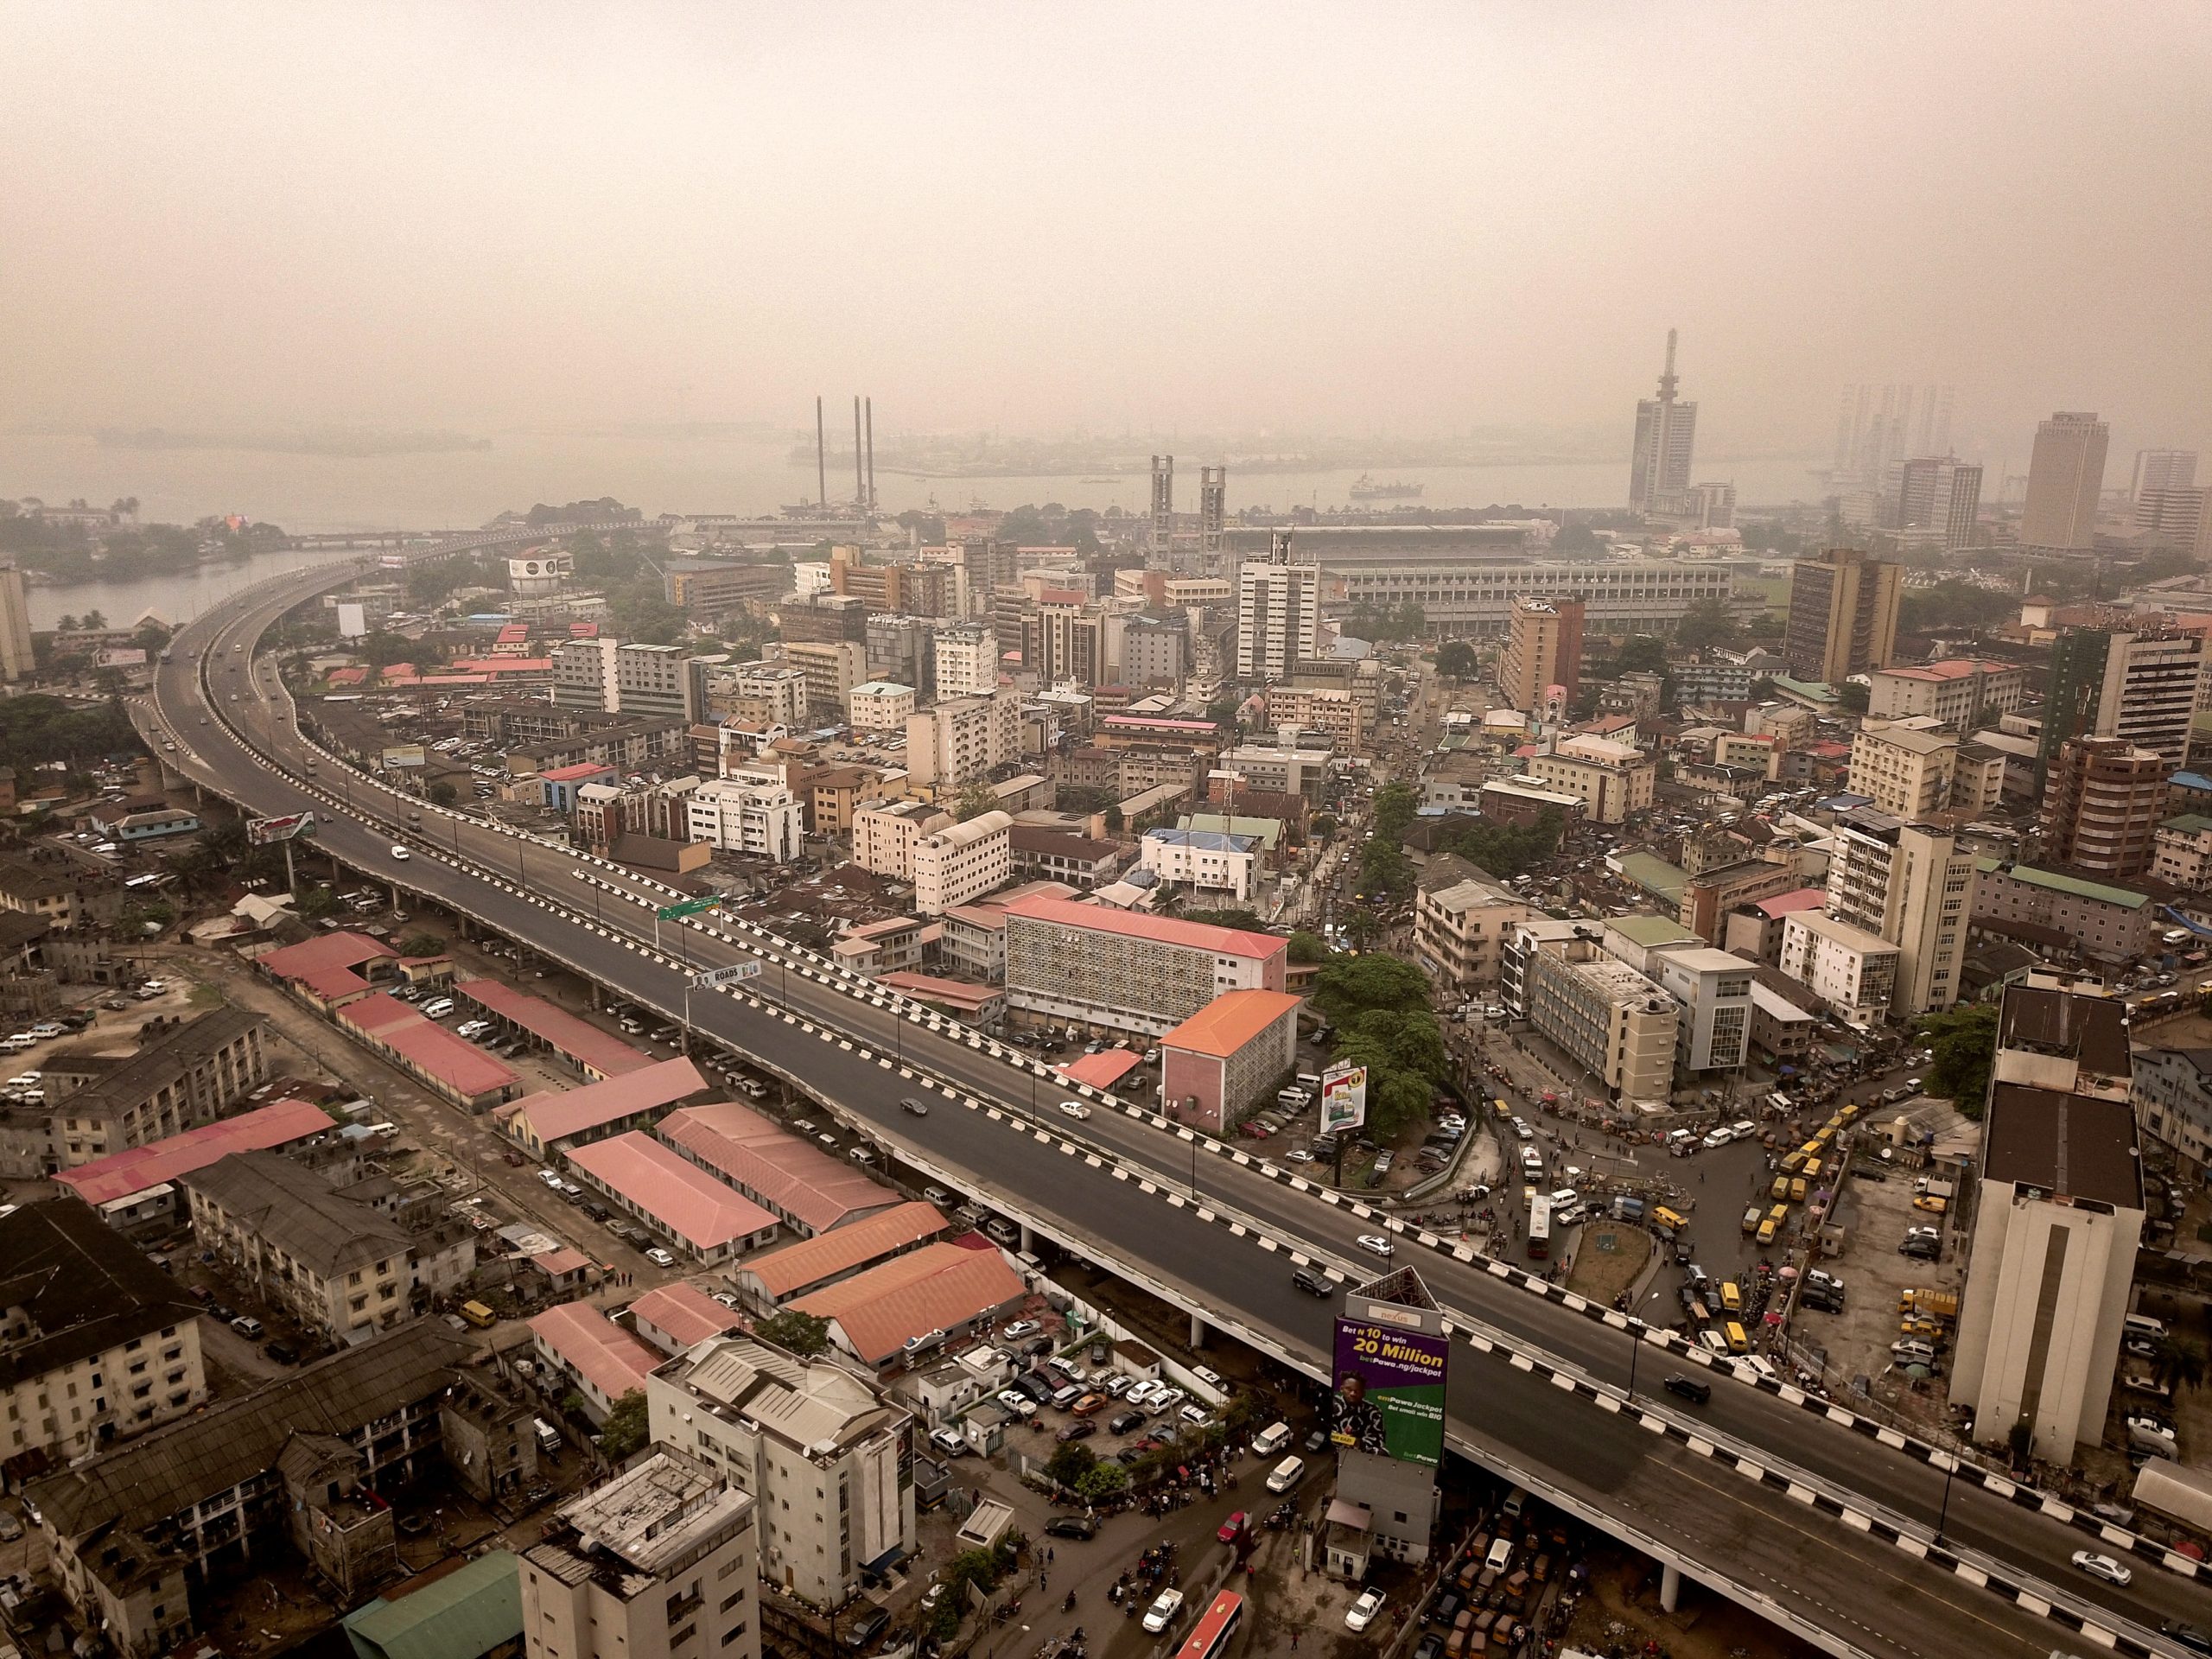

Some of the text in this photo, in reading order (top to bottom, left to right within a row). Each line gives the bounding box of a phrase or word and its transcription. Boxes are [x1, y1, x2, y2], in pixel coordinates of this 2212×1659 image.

[715, 969, 738, 981] ROADS
[1381, 1312, 1408, 1323] nexus
[1343, 1325, 1356, 1334] Bet
[1367, 1327, 1382, 1339] 10
[1392, 1336, 1407, 1344] win
[1353, 1338, 1444, 1367] 20 Million
[1377, 1395, 1443, 1414] emPawa Jackpot
[1399, 1406, 1416, 1415] small
[1403, 1452, 1439, 1464] betPawa
